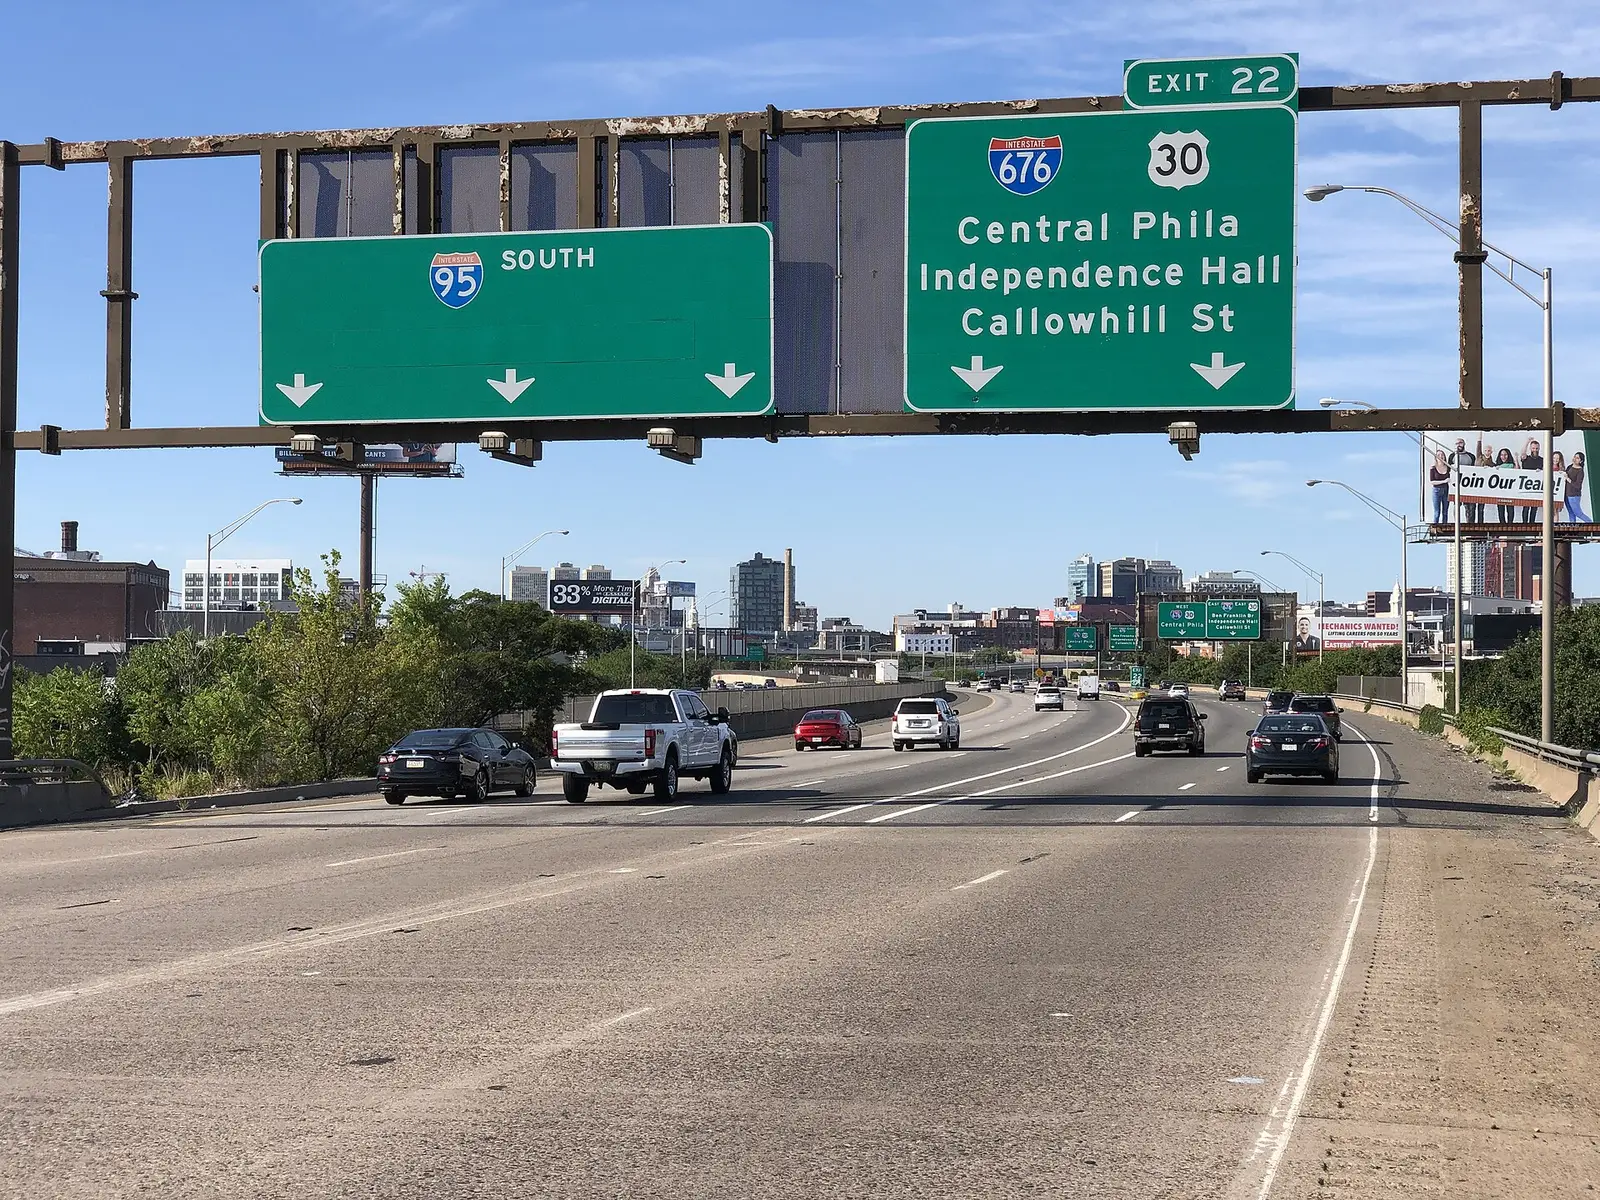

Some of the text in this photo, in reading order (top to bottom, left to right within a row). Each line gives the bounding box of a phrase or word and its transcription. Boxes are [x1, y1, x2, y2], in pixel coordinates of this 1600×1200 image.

[1147, 66, 1280, 94] EXIT 22
[1005, 139, 1046, 149] INTERSTATE
[999, 151, 1052, 185] 676
[1155, 142, 1203, 177] 30
[957, 209, 1239, 245] Central Phila
[438, 256, 475, 264] INTERSTATE
[501, 247, 594, 271] SOUTH
[434, 266, 477, 298] 95
[920, 254, 1281, 296] Independence Hall
[961, 303, 1235, 336] Callowhill St
[1487, 474, 1517, 490] Our
[553, 584, 591, 604] 33%
